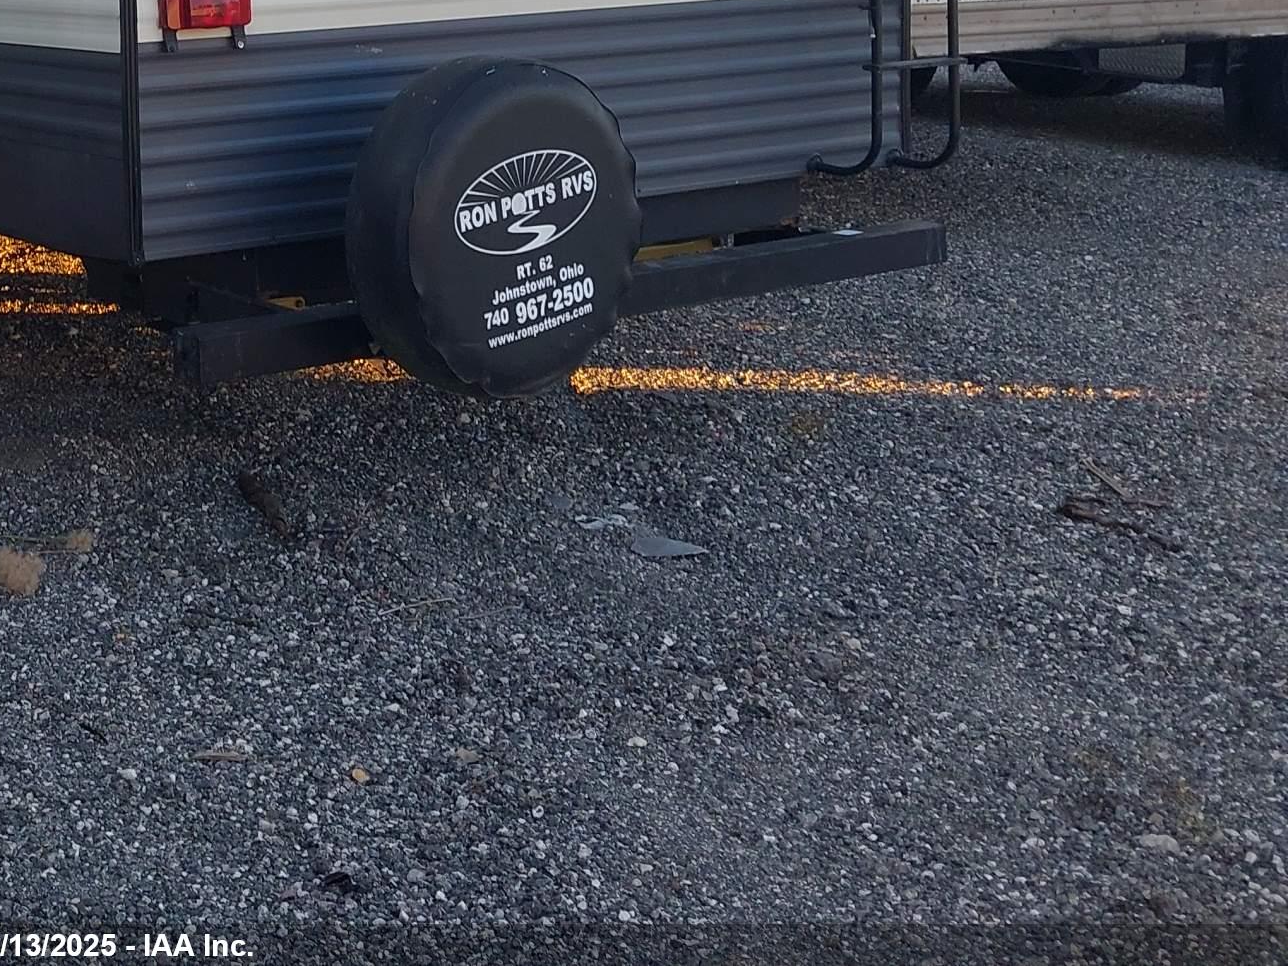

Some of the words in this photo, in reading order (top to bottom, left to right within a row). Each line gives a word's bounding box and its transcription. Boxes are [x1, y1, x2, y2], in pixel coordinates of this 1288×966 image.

[459, 204, 497, 232] RON
[502, 184, 556, 219] POTTS
[561, 171, 593, 199] RVS
[492, 275, 556, 305] Johnstown,
[560, 263, 584, 282] Ohio
[516, 263, 535, 280] RT.
[539, 255, 553, 274] 62
[484, 309, 510, 330] 740
[515, 278, 594, 324] 967-2500
[488, 303, 593, 349] www.ronpottsrvs.com
